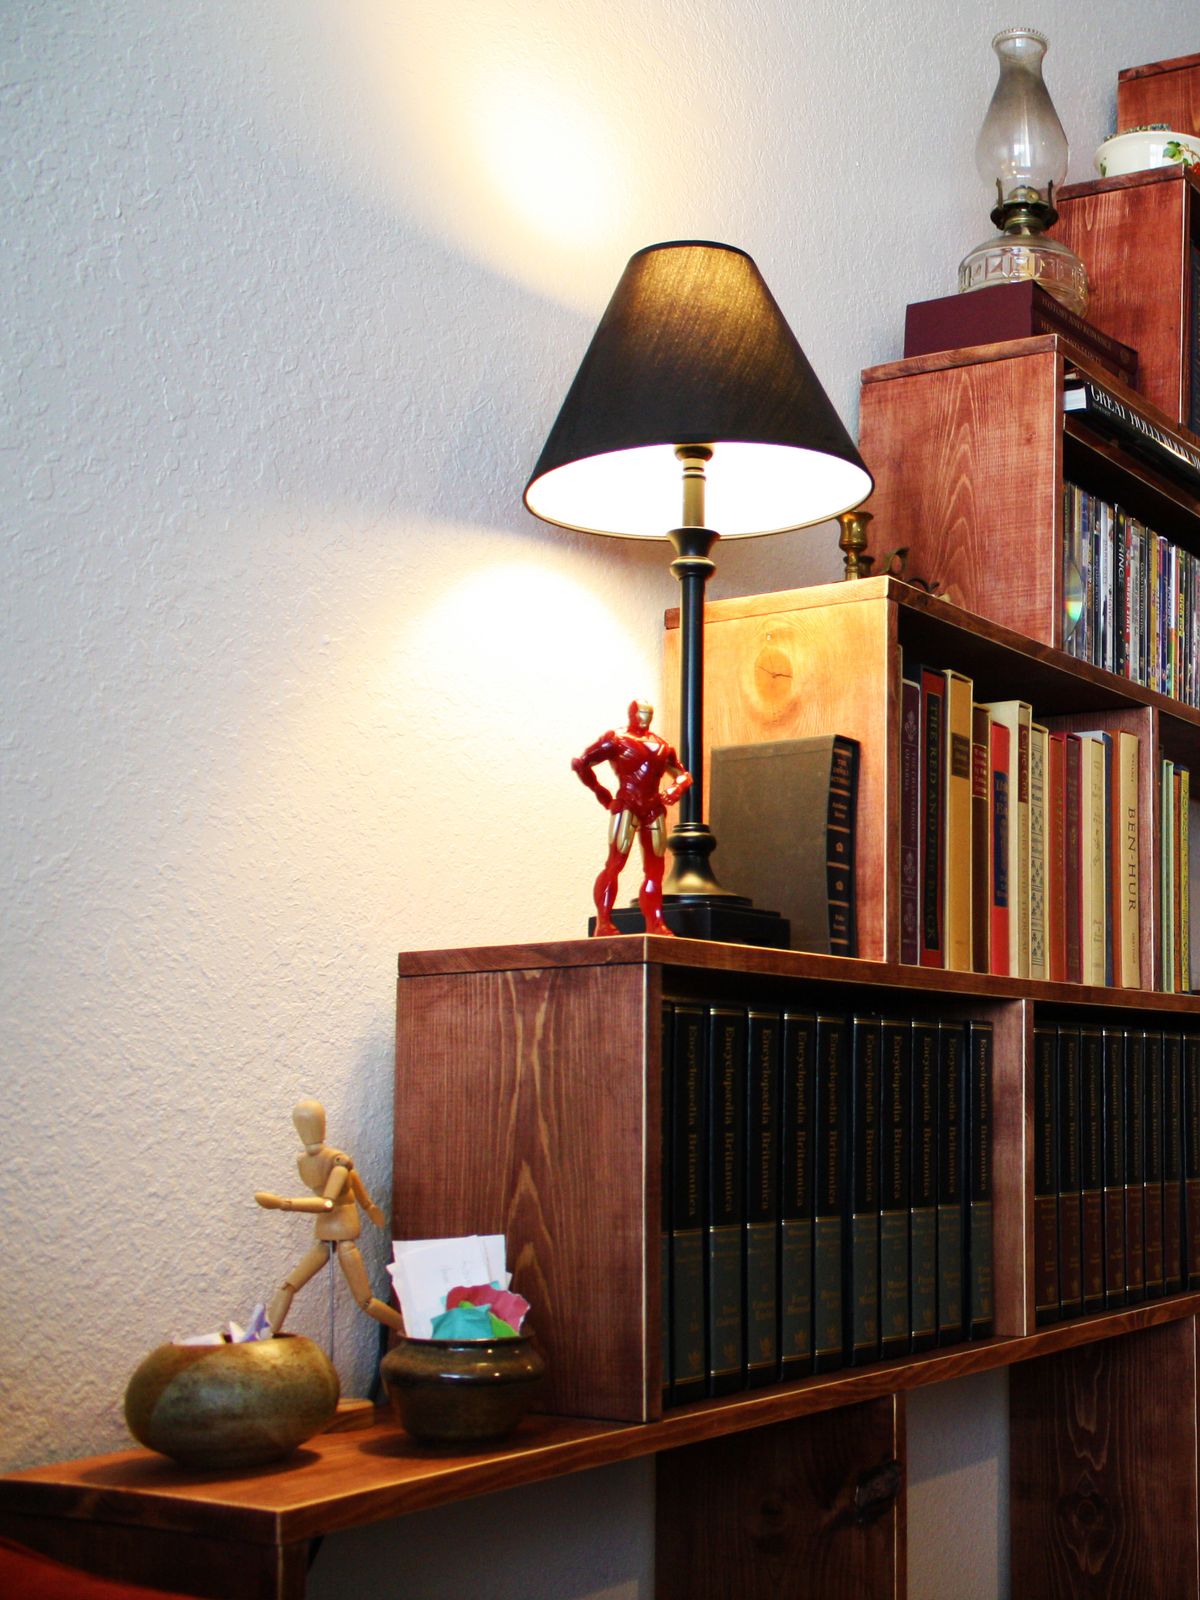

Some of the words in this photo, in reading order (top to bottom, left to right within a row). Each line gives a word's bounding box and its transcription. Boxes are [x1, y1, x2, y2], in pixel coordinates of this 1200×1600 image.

[1090, 384, 1127, 421] GREAT
[1128, 410, 1191, 462] HOLLYWOOD
[930, 703, 939, 741] THE
[1018, 729, 1029, 768] Cape
[930, 747, 939, 785] RED
[1020, 773, 1028, 800] Cod
[929, 790, 938, 832] AND
[1128, 807, 1137, 912] BEN-HUR
[687, 1132, 697, 1216] Britannica
[723, 1131, 735, 1214] Britannica
[759, 1131, 772, 1212] Britannica
[795, 1130, 807, 1208] Britannica
[827, 1130, 839, 1208] Britannica
[864, 1128, 875, 1202] Britannica
[892, 1127, 903, 1201] Britannica
[921, 1126, 932, 1199] Britannica
[947, 1126, 957, 1196] Britannica
[978, 1125, 988, 1191] Britannica
